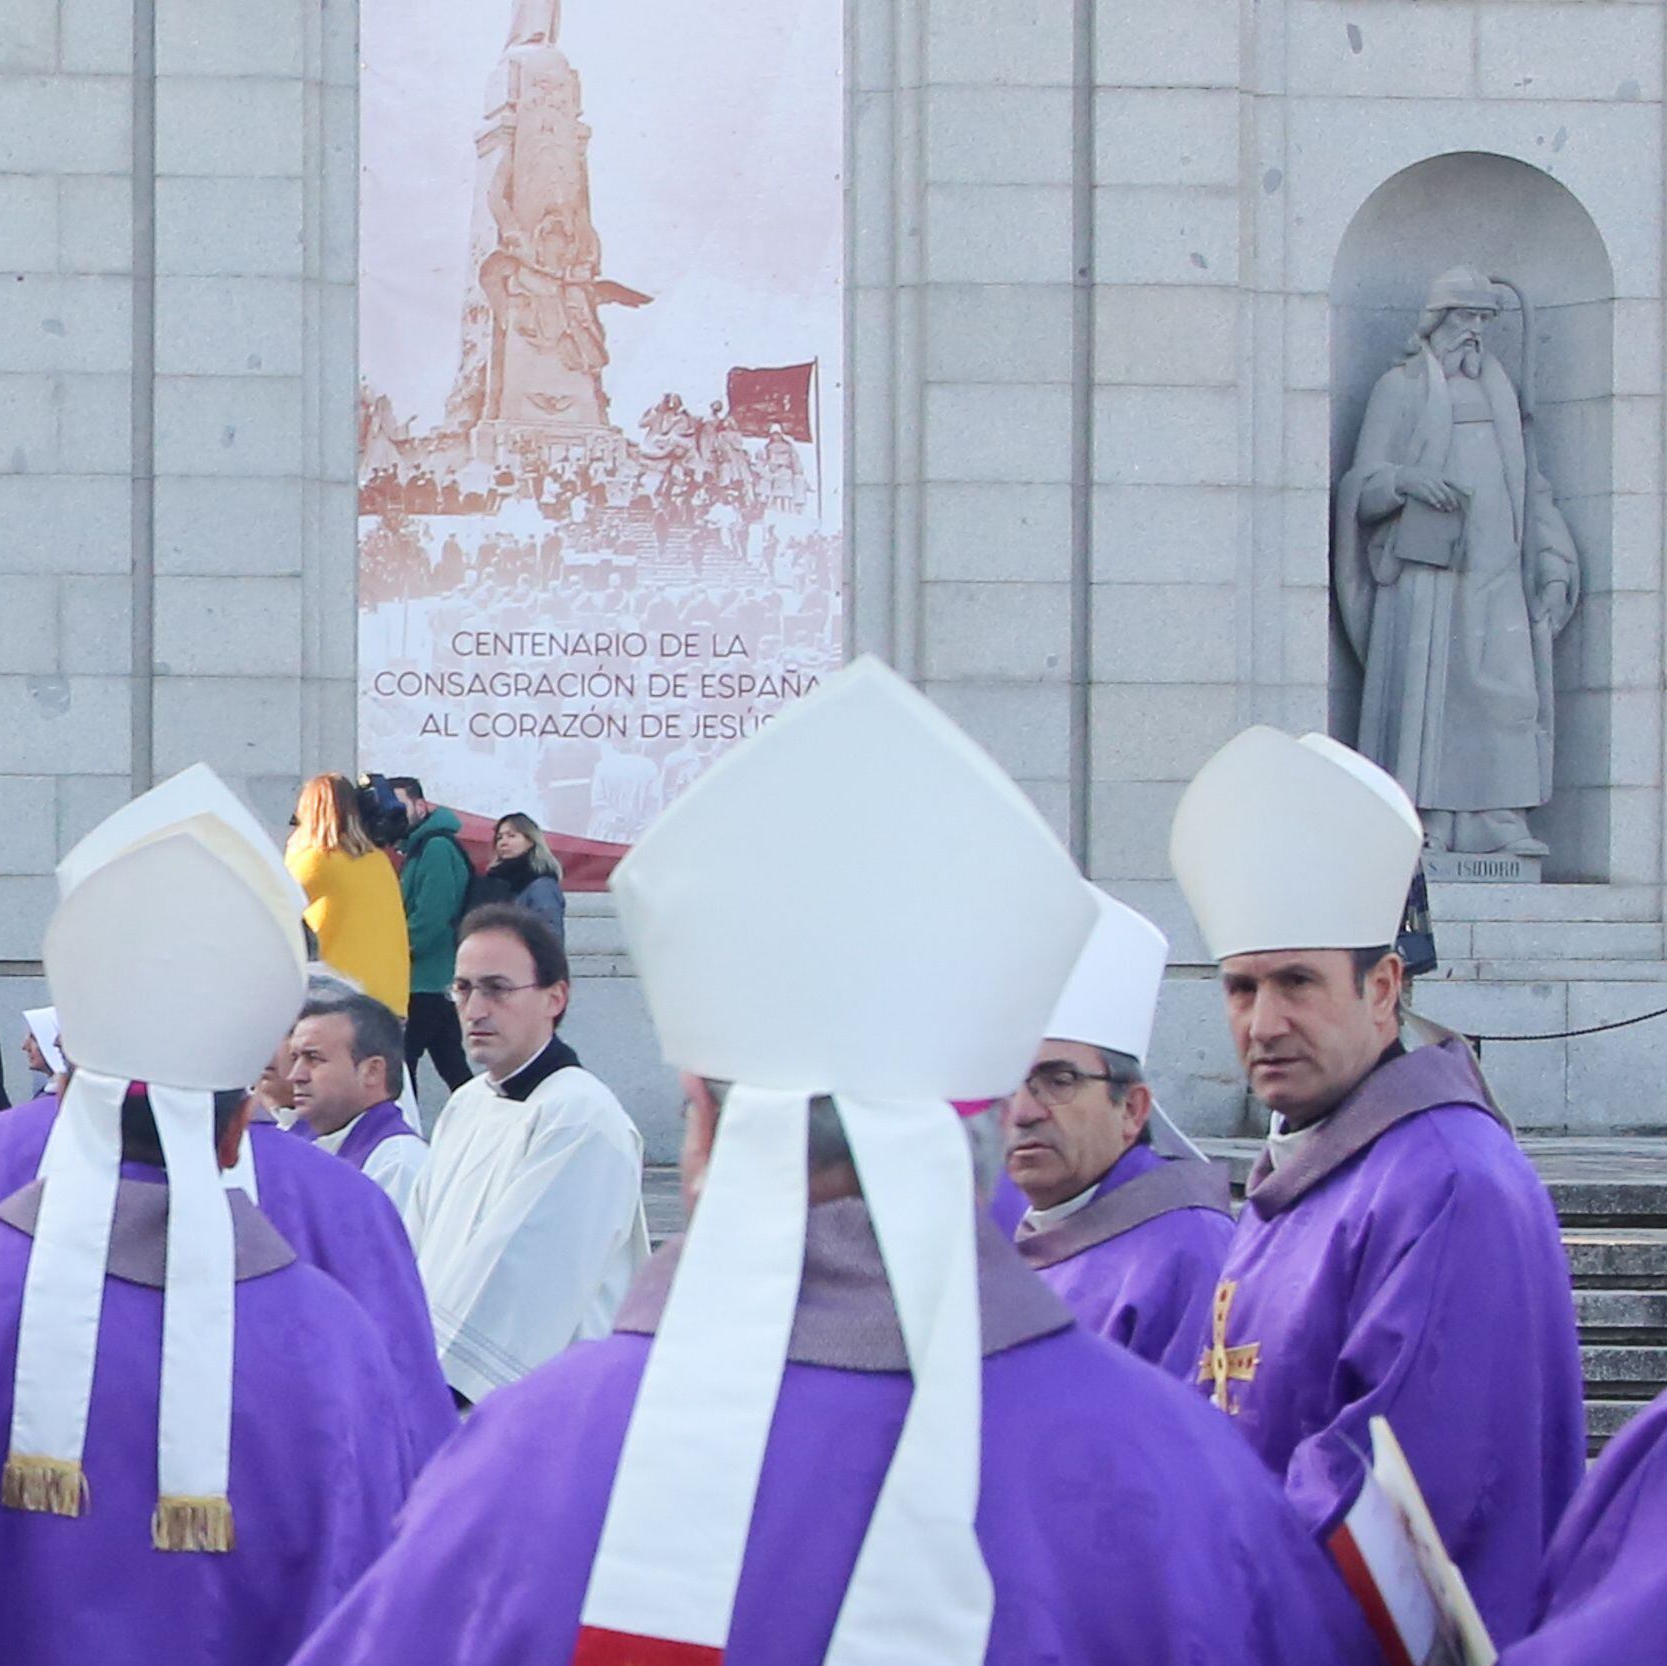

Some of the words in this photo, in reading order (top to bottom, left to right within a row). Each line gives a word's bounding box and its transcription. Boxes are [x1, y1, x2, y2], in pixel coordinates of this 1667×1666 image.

[451, 631, 648, 658] CENTENARIO
[659, 632, 700, 658] DE
[712, 632, 749, 658] LA
[374, 664, 635, 698] CONSAGRACIÓN
[648, 673, 688, 698] DE
[419, 713, 459, 737] AL
[469, 705, 627, 738] CORAZÓN
[641, 714, 681, 738] DE
